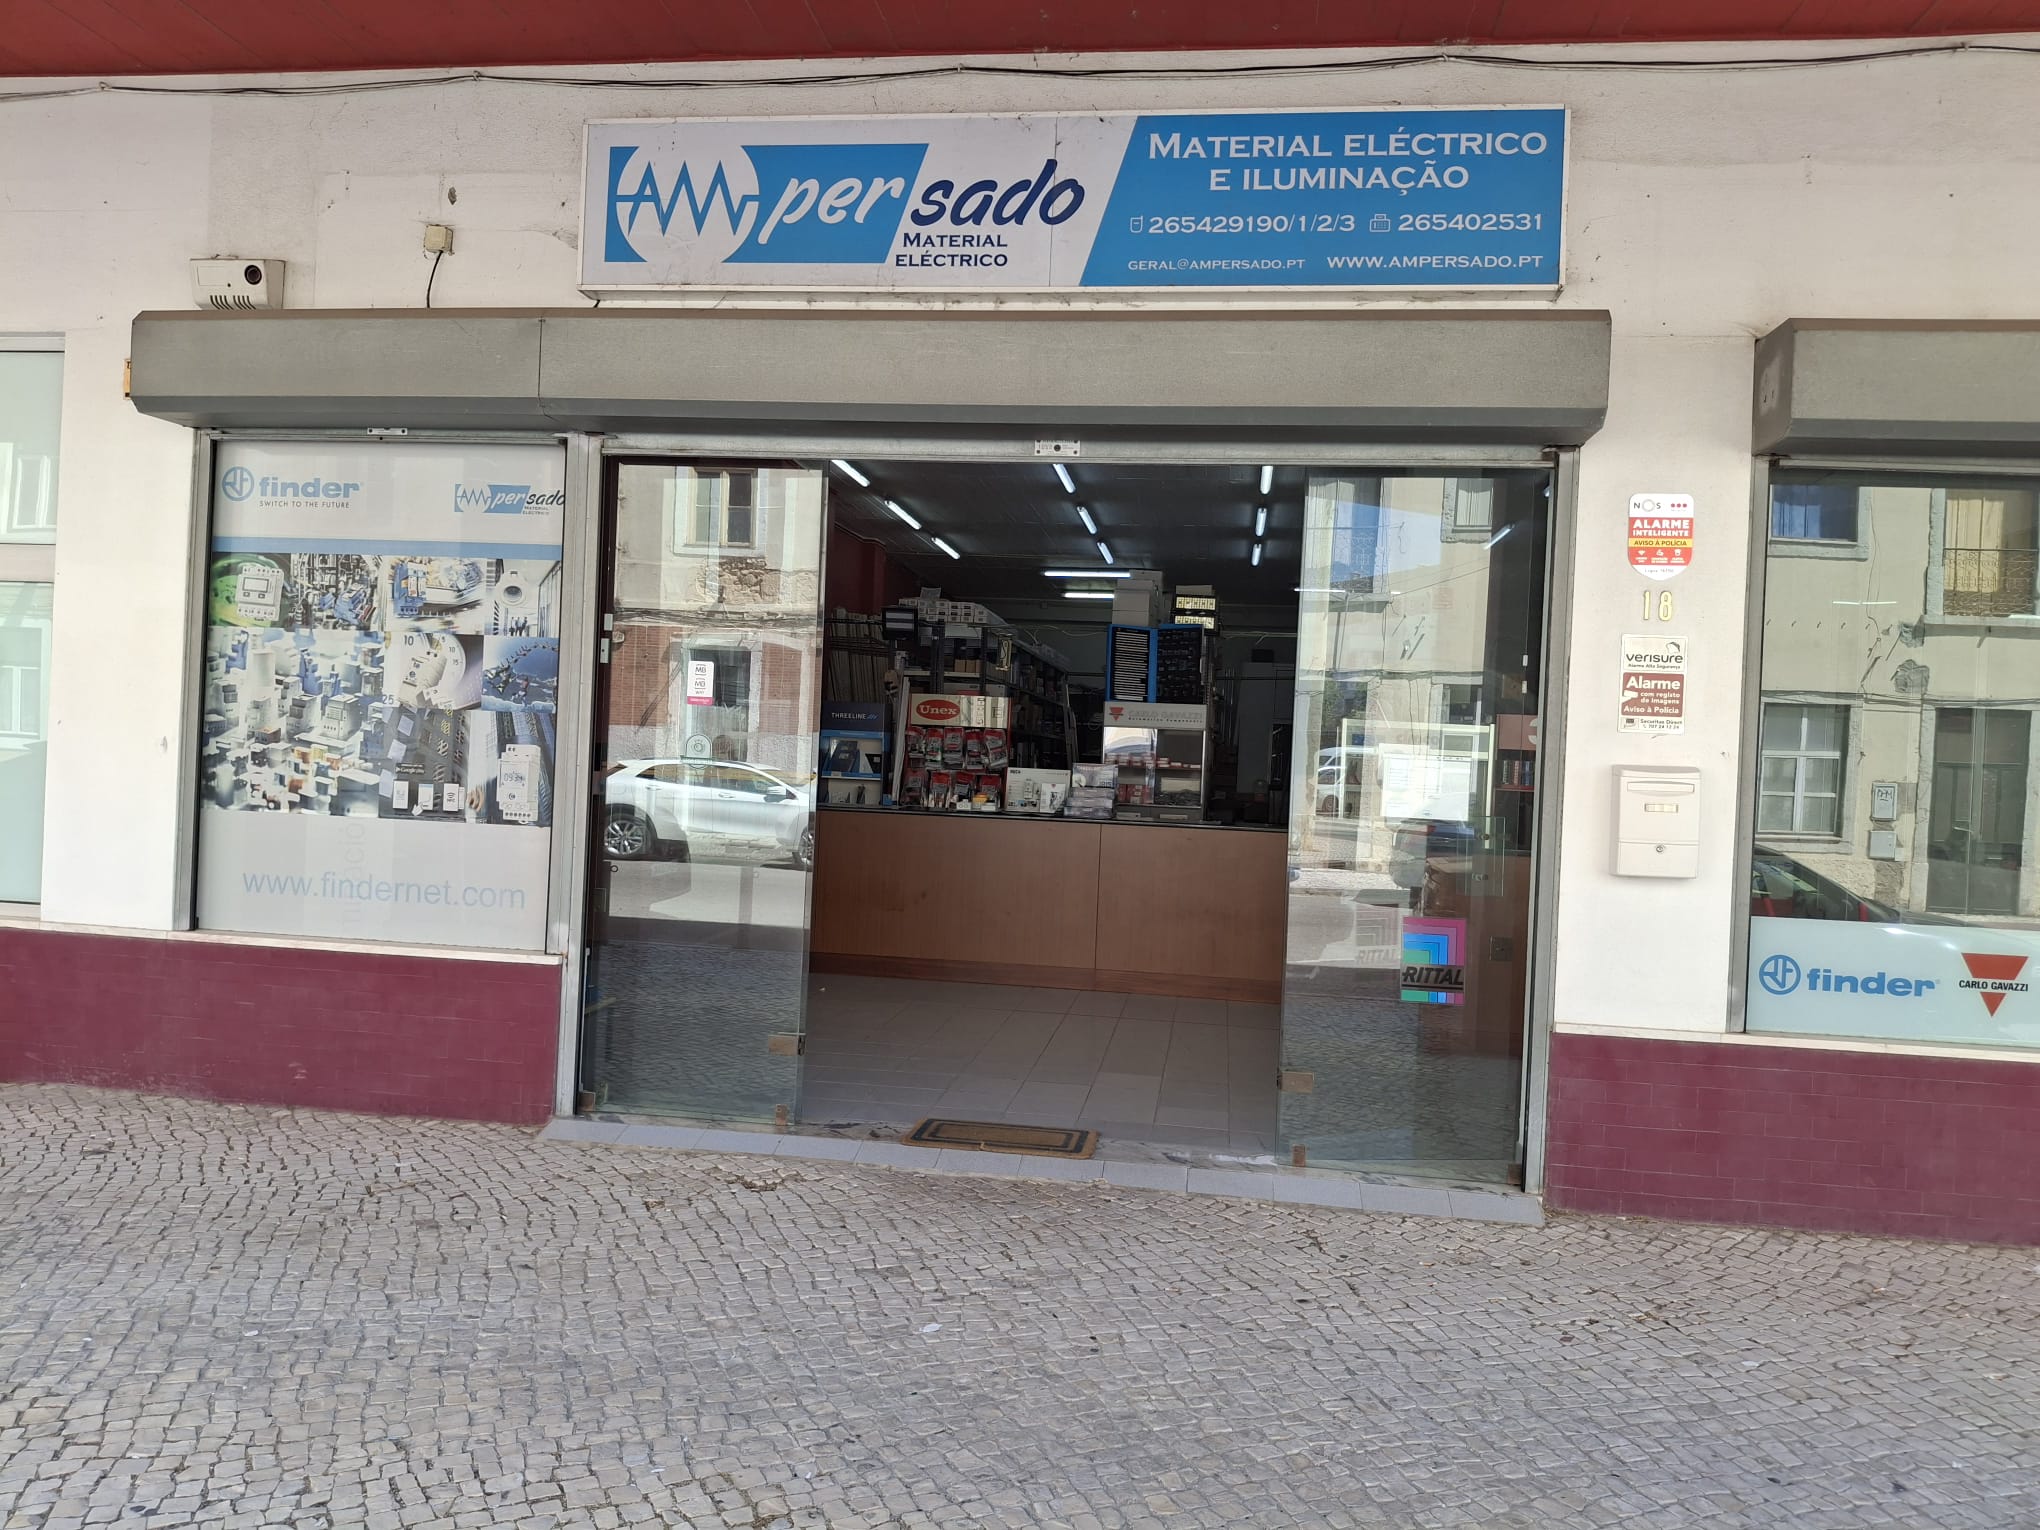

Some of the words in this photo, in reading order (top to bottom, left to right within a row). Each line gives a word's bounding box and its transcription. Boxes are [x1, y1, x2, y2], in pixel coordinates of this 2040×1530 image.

[1148, 133, 1332, 159] MATERIAL
[1343, 127, 1547, 157] ELÉCTRICO
[1209, 168, 1230, 191] E
[1242, 160, 1469, 196] ILUMINAÇÃO
[1148, 213, 1356, 234] 265429190/1/2/3
[1398, 212, 1542, 232] 265402531
[902, 232, 1008, 248] MATERIAL
[895, 249, 1008, 267] ELÉCTRICO
[1127, 259, 1306, 270] GERAL@AMPERSADO.PT
[1326, 254, 1544, 269] WWW.AMPERSADO.PT
[259, 477, 360, 498] finder
[321, 501, 350, 509] FUTURE
[1632, 519, 1690, 529] ALARME
[1632, 529, 1689, 537] INTELIGENTE
[1661, 538, 1687, 546] POLÍCIA
[1625, 653, 1684, 663] verisure
[1626, 675, 1681, 690] Alarme
[1656, 691, 1681, 699] registo
[919, 704, 958, 715] Unex
[1623, 705, 1645, 713] Aviso
[1654, 706, 1679, 714] Polícia
[243, 871, 526, 910] www.findernet.com
[1402, 966, 1464, 986] RITTAL
[1807, 968, 1935, 997] finder
[1958, 979, 1989, 990] CARLO
[1990, 981, 2029, 992] GAVAZZI
